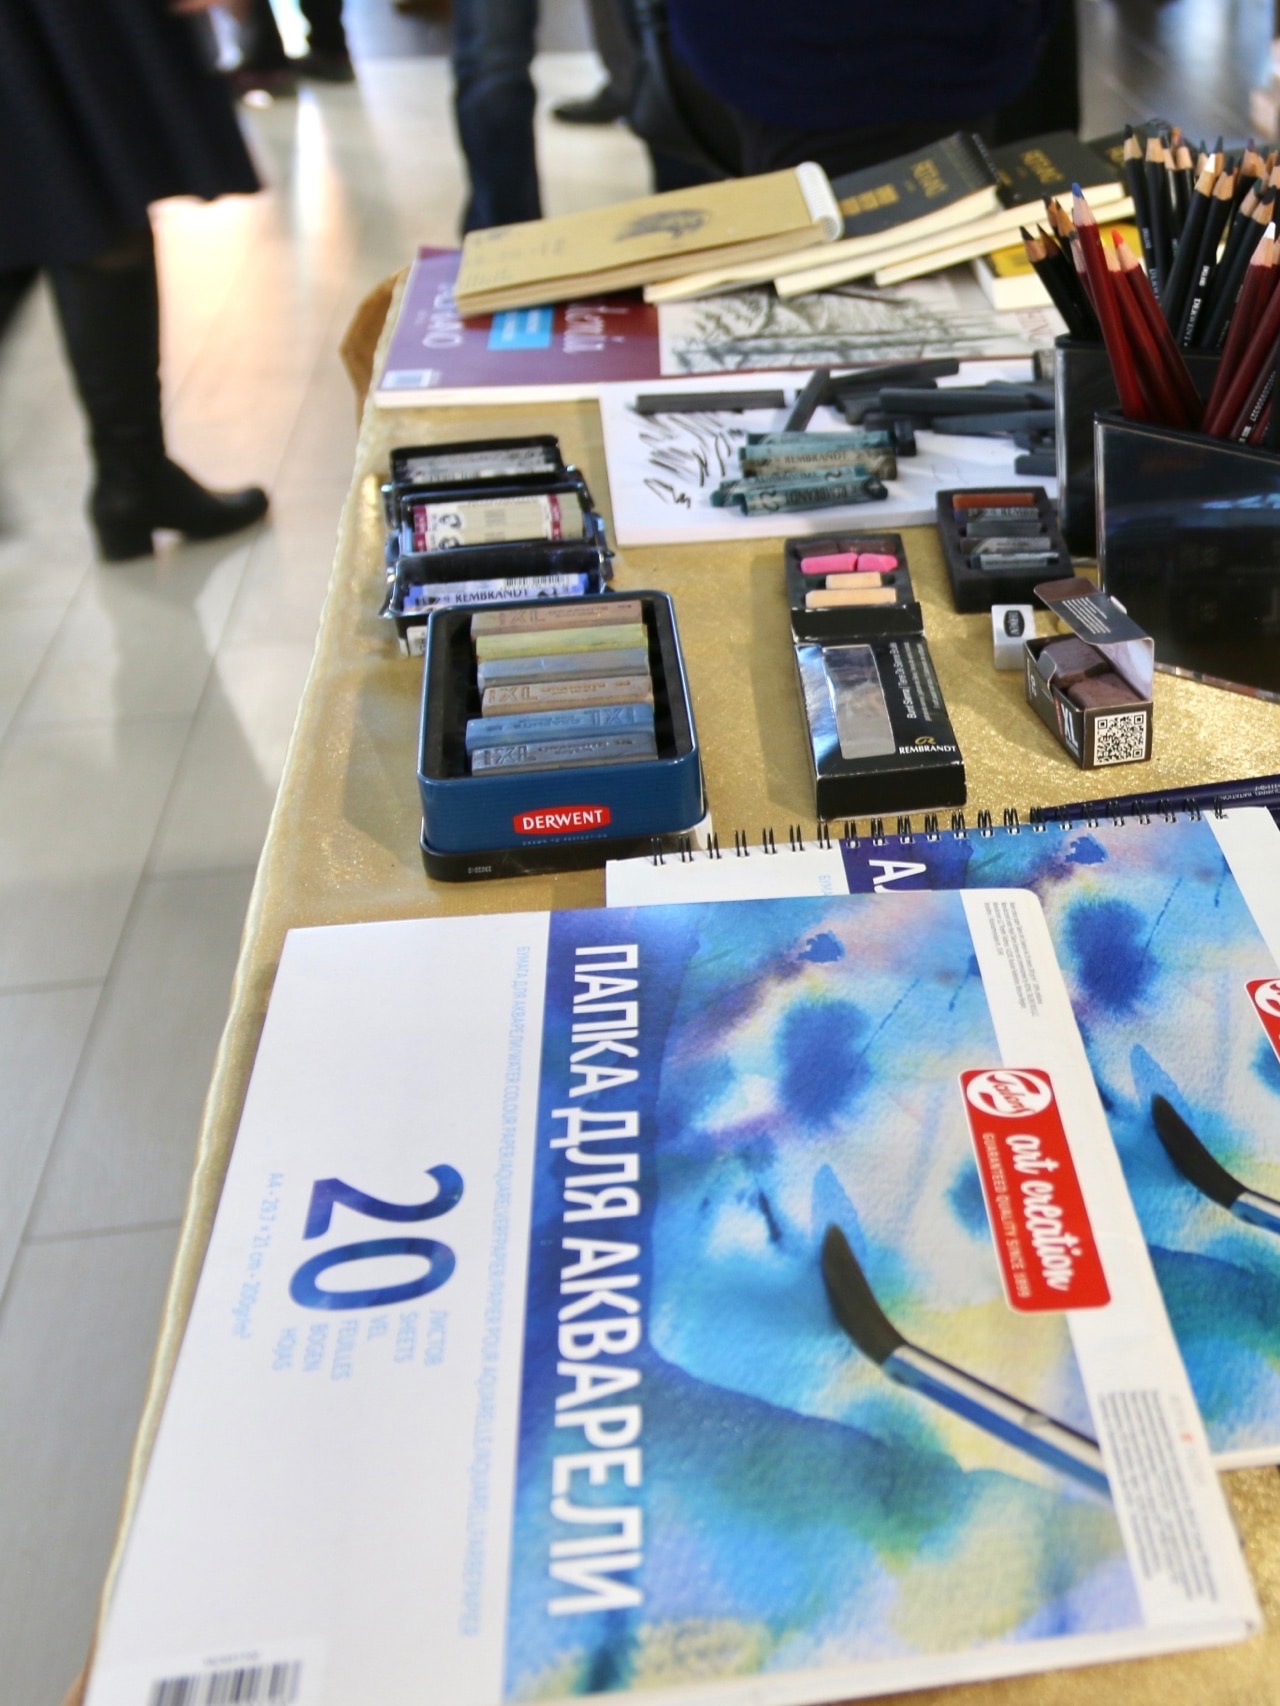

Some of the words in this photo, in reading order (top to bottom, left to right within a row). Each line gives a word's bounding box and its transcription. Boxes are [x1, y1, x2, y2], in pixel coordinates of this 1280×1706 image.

[455, 589, 527, 603] REMBRANDT
[898, 743, 957, 757] REMBRANDT
[522, 809, 602, 830] DERWENT
[513, 946, 530, 979] БУМАГА
[567, 943, 638, 1098] ПАПКА
[550, 1105, 639, 1222] ДЛЯ
[982, 1132, 1008, 1193] GUARANTEED
[1005, 1135, 1059, 1173] art
[267, 1171, 284, 1188] A4
[288, 1164, 465, 1310] 20
[995, 1194, 1017, 1237] QUALITY
[1021, 1183, 1082, 1290] creation
[1005, 1238, 1024, 1270] SINCE
[1012, 1272, 1030, 1298] 1899
[271, 1326, 297, 1371] HOJAS
[302, 1323, 328, 1372] BOGEN
[330, 1318, 359, 1381] FEUILLES
[366, 1314, 388, 1341] VEL
[393, 1311, 419, 1362] SHEETS
[548, 1236, 645, 1617] АКВАРЕЛИ
